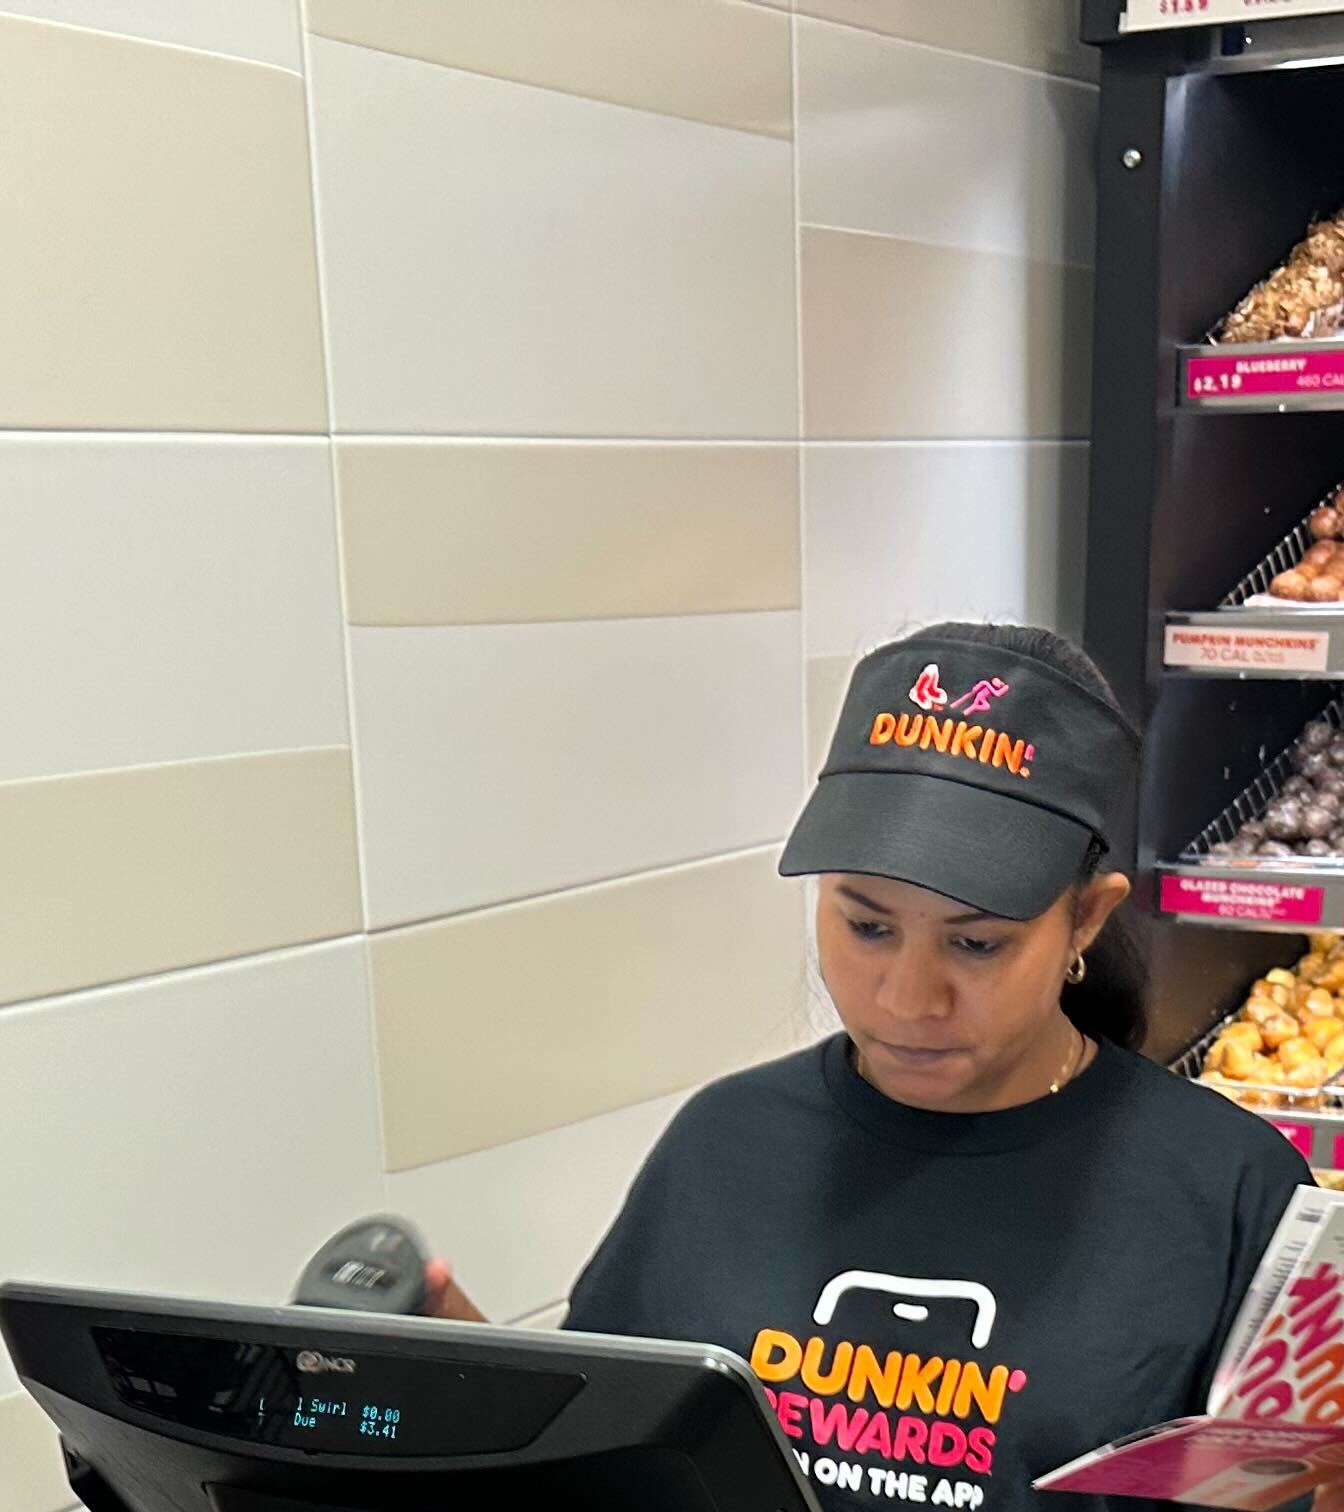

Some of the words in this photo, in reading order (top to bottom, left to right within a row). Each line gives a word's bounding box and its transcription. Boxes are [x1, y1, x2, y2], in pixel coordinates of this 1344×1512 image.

[1236, 360, 1307, 374] BLUEBERRY
[1172, 633, 1230, 646] PUMPKIN
[1220, 648, 1250, 662] CAL
[750, 1328, 1027, 1424] DUNKIN'
[311, 1398, 347, 1415] Swirl
[362, 1405, 401, 1423] $0.00
[293, 1412, 317, 1428] Due
[360, 1421, 397, 1439] $3.41
[814, 1457, 862, 1491] ON
[867, 1466, 927, 1503] THE
